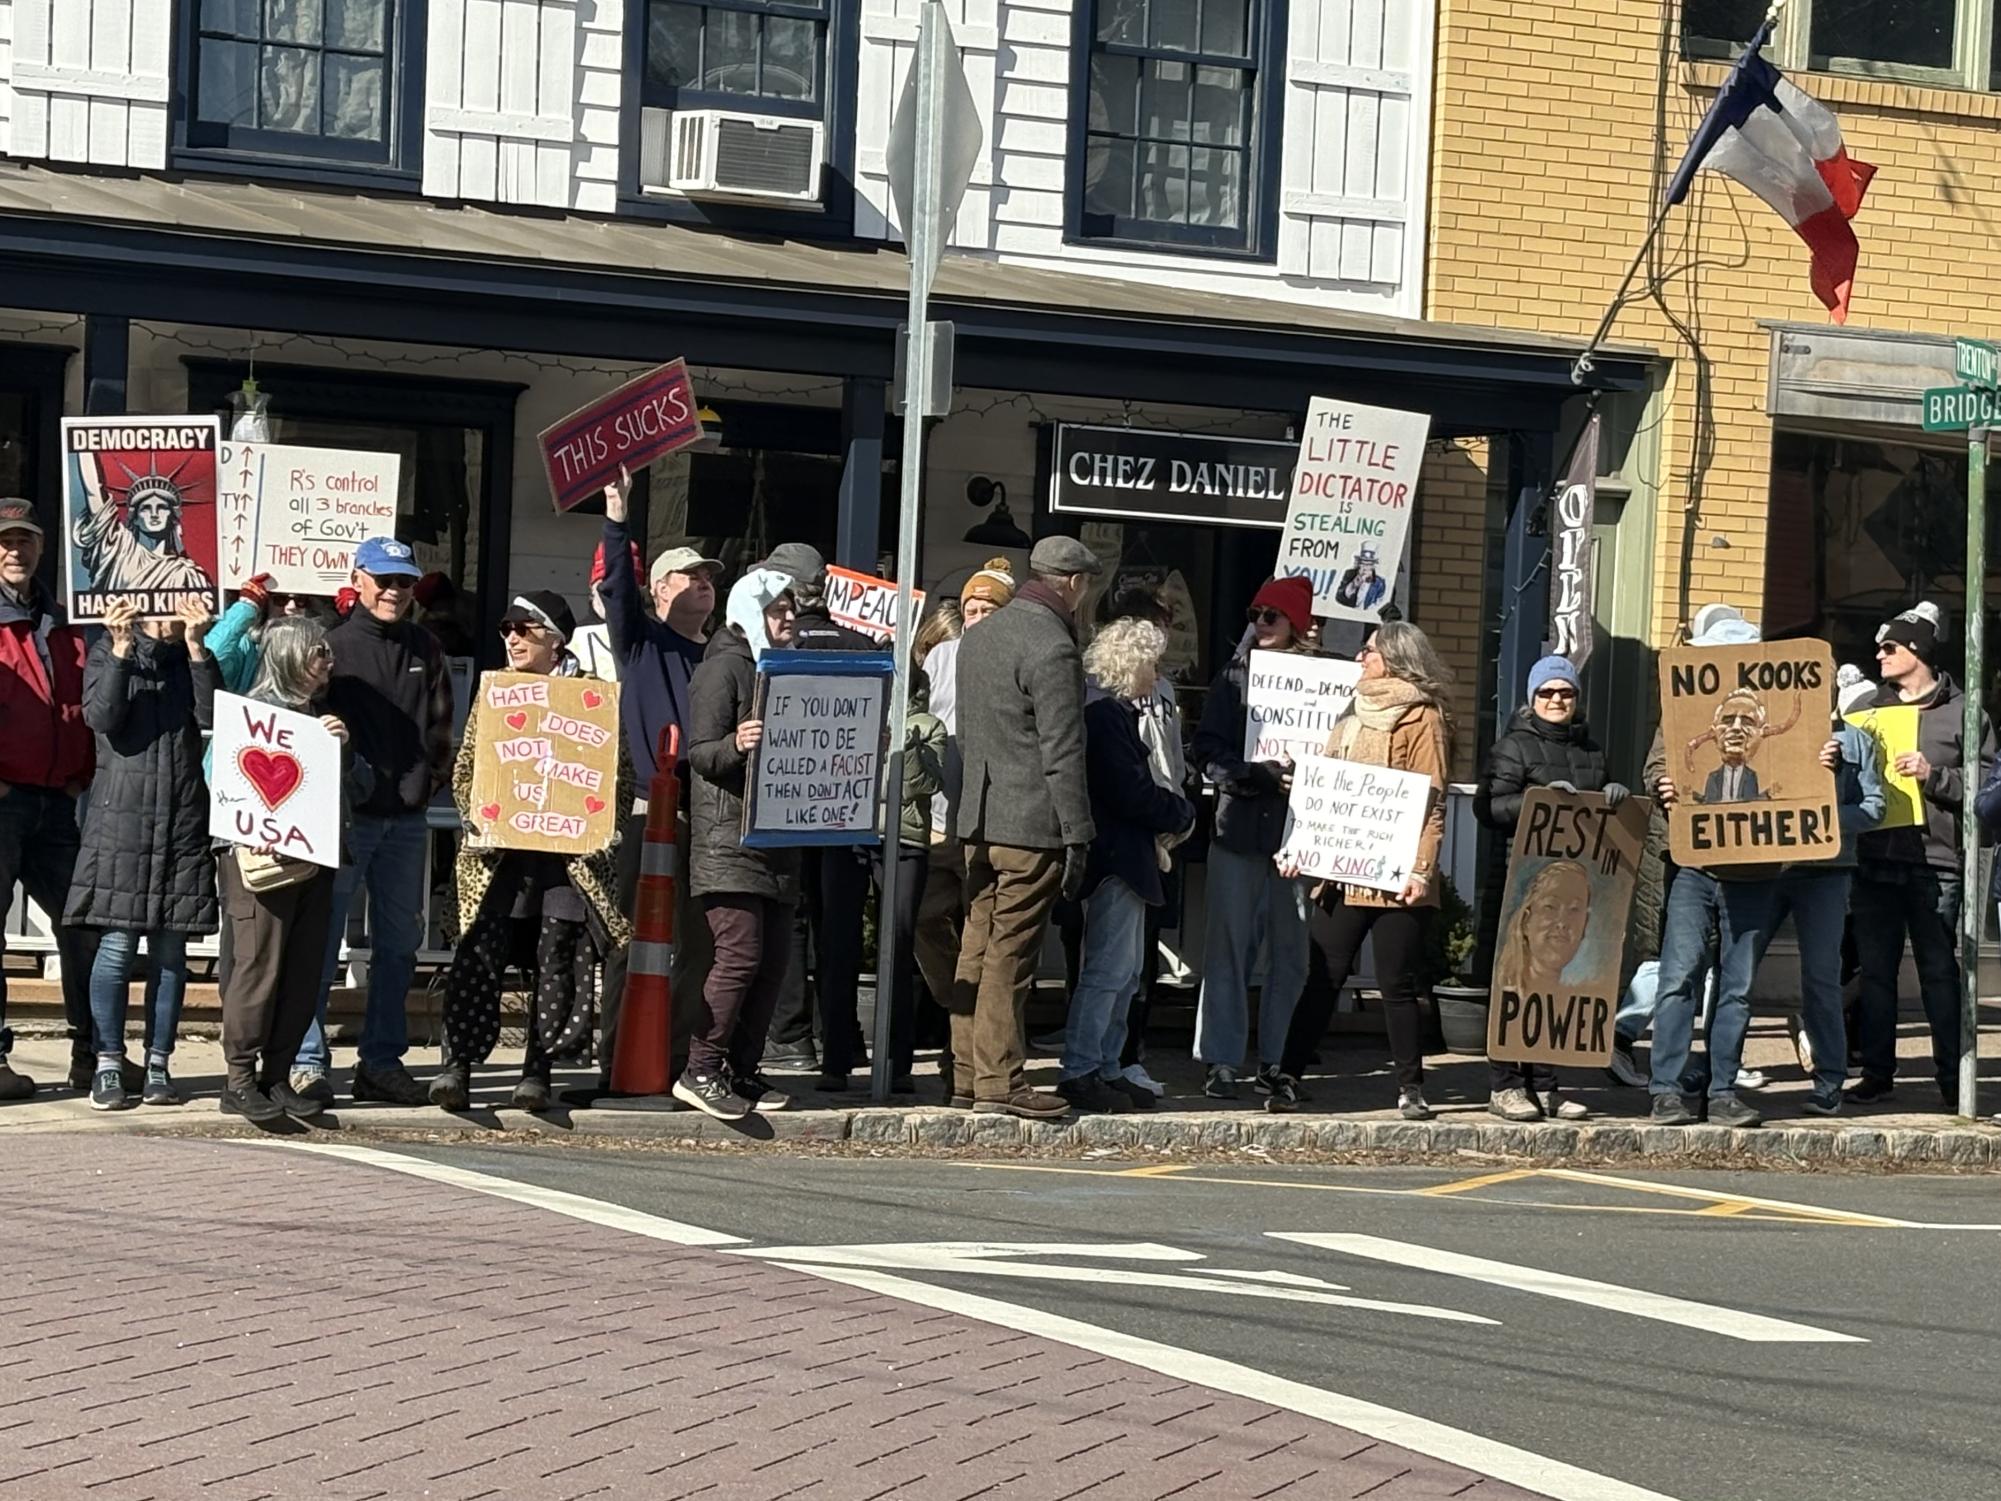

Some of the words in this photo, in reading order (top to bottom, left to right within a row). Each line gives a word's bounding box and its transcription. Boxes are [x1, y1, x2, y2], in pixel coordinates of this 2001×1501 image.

[1956, 341, 1991, 381] TRENTON
[1317, 412, 1353, 429] THE
[72, 428, 209, 450] DEMOCRACY
[554, 426, 608, 482] THIS
[615, 387, 688, 450] SUCKS
[1308, 437, 1400, 470] LITTLE
[290, 469, 315, 492] R's
[326, 470, 378, 493] control
[1069, 451, 1156, 490] CHEZ
[1169, 460, 1285, 500] DANIEL
[1300, 472, 1408, 509] DICTATOR
[289, 497, 310, 515] all
[316, 498, 330, 511] 3
[336, 498, 393, 517] branches
[1339, 501, 1353, 514] IS
[291, 519, 312, 536] of
[1293, 512, 1386, 536] STEALING
[265, 544, 308, 567] THEY
[313, 548, 348, 569] OWN
[1289, 538, 1339, 560] FROM
[1552, 484, 1588, 655] OPEN
[1251, 673, 1303, 692] DEFEND
[1671, 663, 1720, 697] NO
[1737, 660, 1822, 692] KOOKS
[492, 685, 545, 706] HATE
[773, 696, 791, 716] IF
[801, 697, 829, 718] YOU
[243, 705, 294, 749] WE
[1250, 704, 1339, 731] CONSTITU
[548, 715, 605, 745] DOES
[768, 728, 806, 749] WANT
[811, 729, 830, 749] TO
[836, 728, 856, 750] BE
[502, 740, 544, 758] NOT
[1255, 737, 1295, 757] NOT
[541, 760, 599, 788] MAKE
[767, 757, 817, 776] CALLED
[820, 760, 827, 773] A
[831, 753, 873, 777] FACIST
[518, 784, 543, 801] US
[764, 783, 801, 799] THEN
[842, 777, 873, 801] ACT
[1304, 765, 1325, 788] We
[1333, 769, 1353, 792] the
[1351, 773, 1409, 804] People
[786, 805, 818, 824] LIKE
[822, 802, 859, 824] ONE!
[1305, 797, 1323, 811] DO
[1329, 800, 1358, 817] NOT
[1361, 805, 1405, 824] EXIST
[235, 810, 314, 853] USA
[515, 813, 584, 835] GREAT
[1691, 805, 1833, 850] EITHER!
[1523, 802, 1617, 862] REST
[1601, 847, 1620, 876] IN
[1296, 849, 1321, 868] NO
[1498, 990, 1609, 1053] POWER
